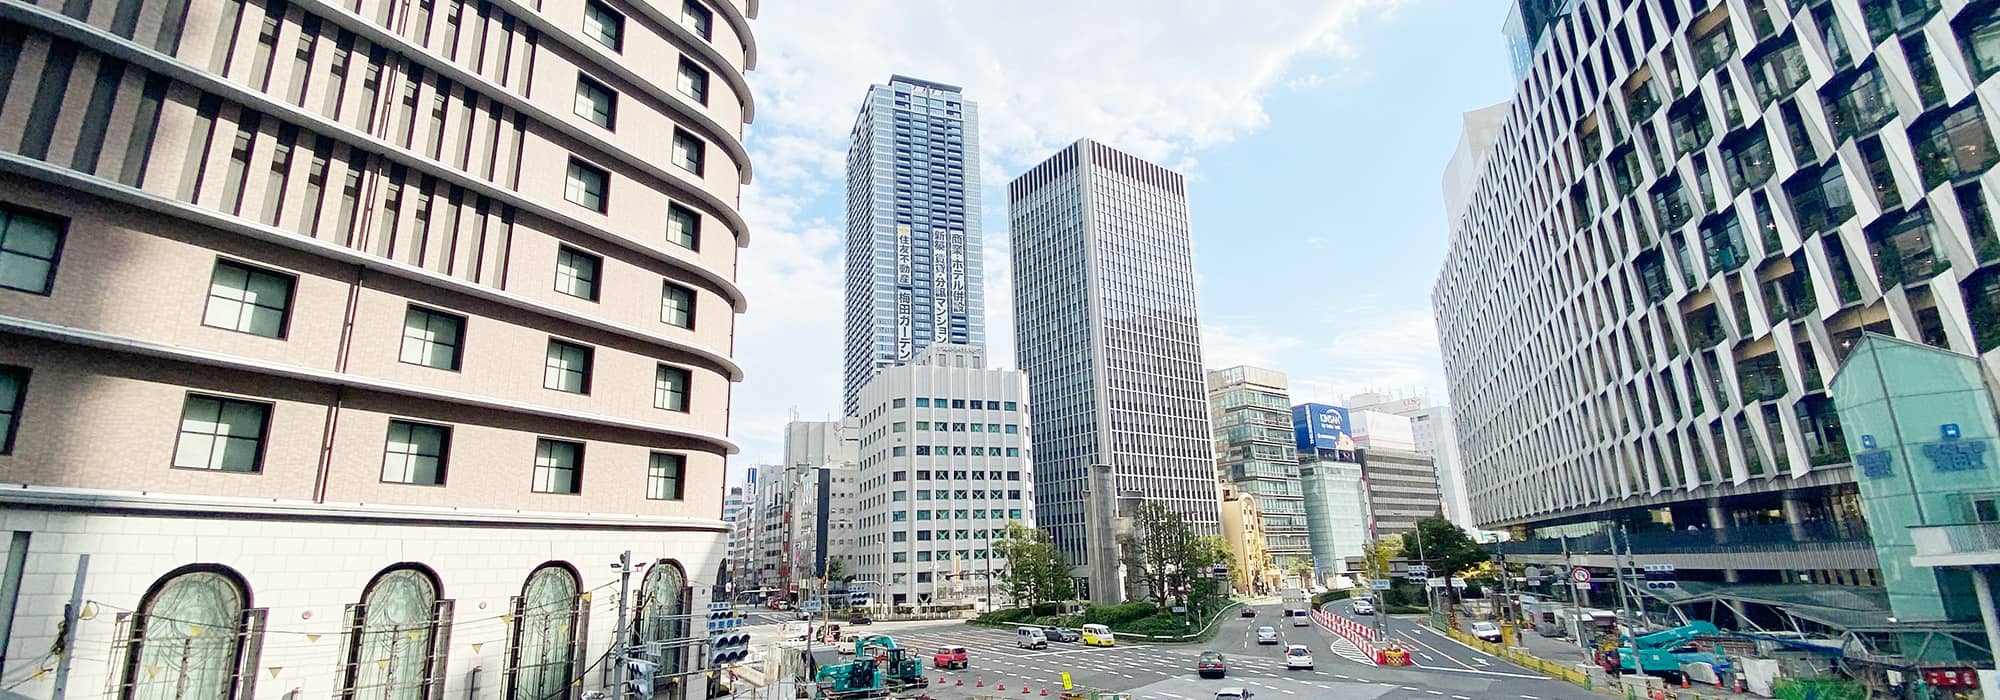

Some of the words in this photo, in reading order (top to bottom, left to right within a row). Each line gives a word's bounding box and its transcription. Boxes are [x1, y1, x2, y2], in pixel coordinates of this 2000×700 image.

[898, 234, 910, 283] 住友不動産
